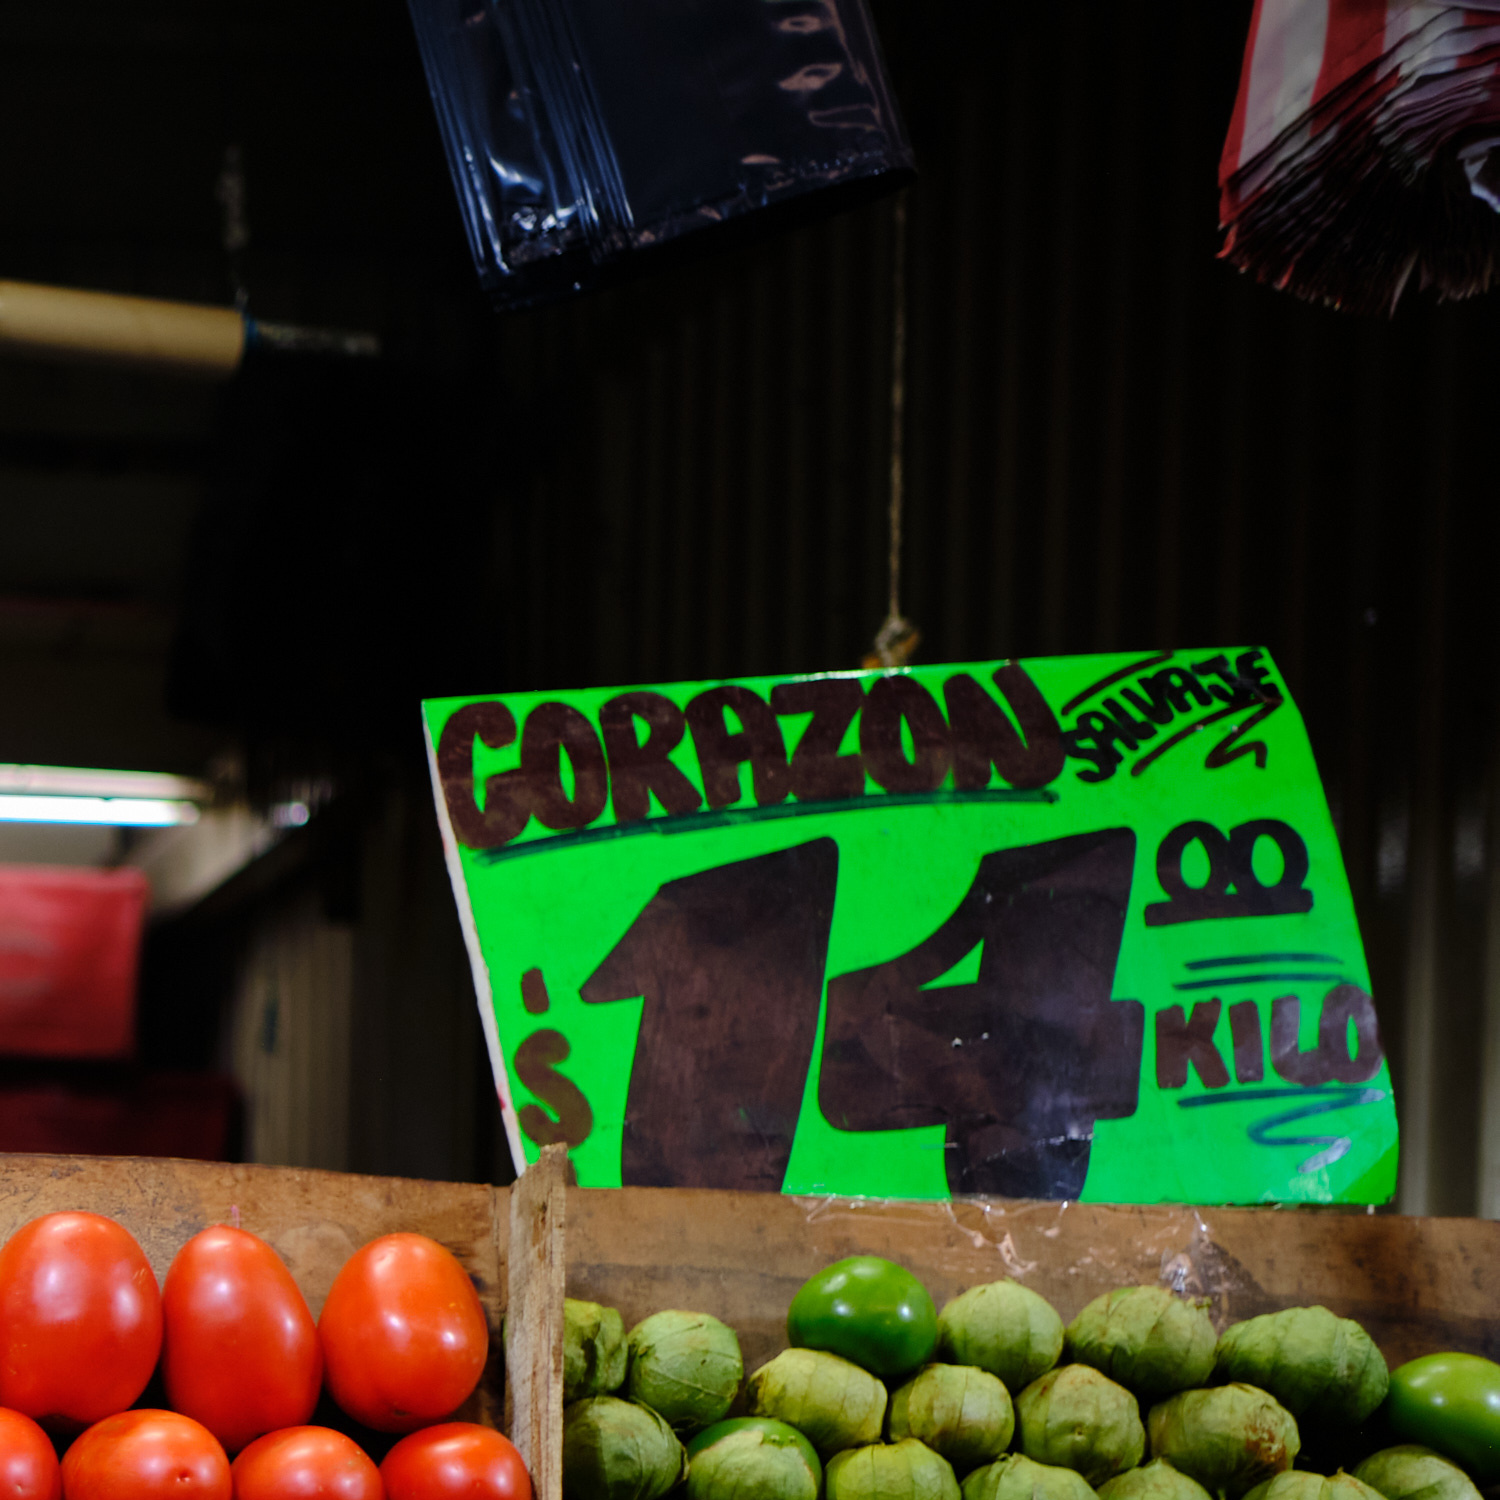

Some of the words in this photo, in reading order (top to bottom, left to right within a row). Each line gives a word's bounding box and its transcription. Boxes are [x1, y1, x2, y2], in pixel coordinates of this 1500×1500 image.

[437, 660, 1068, 851] CORAZON
[1060, 650, 1283, 783] SALVAJE
[1156, 982, 1384, 1091] KILO
